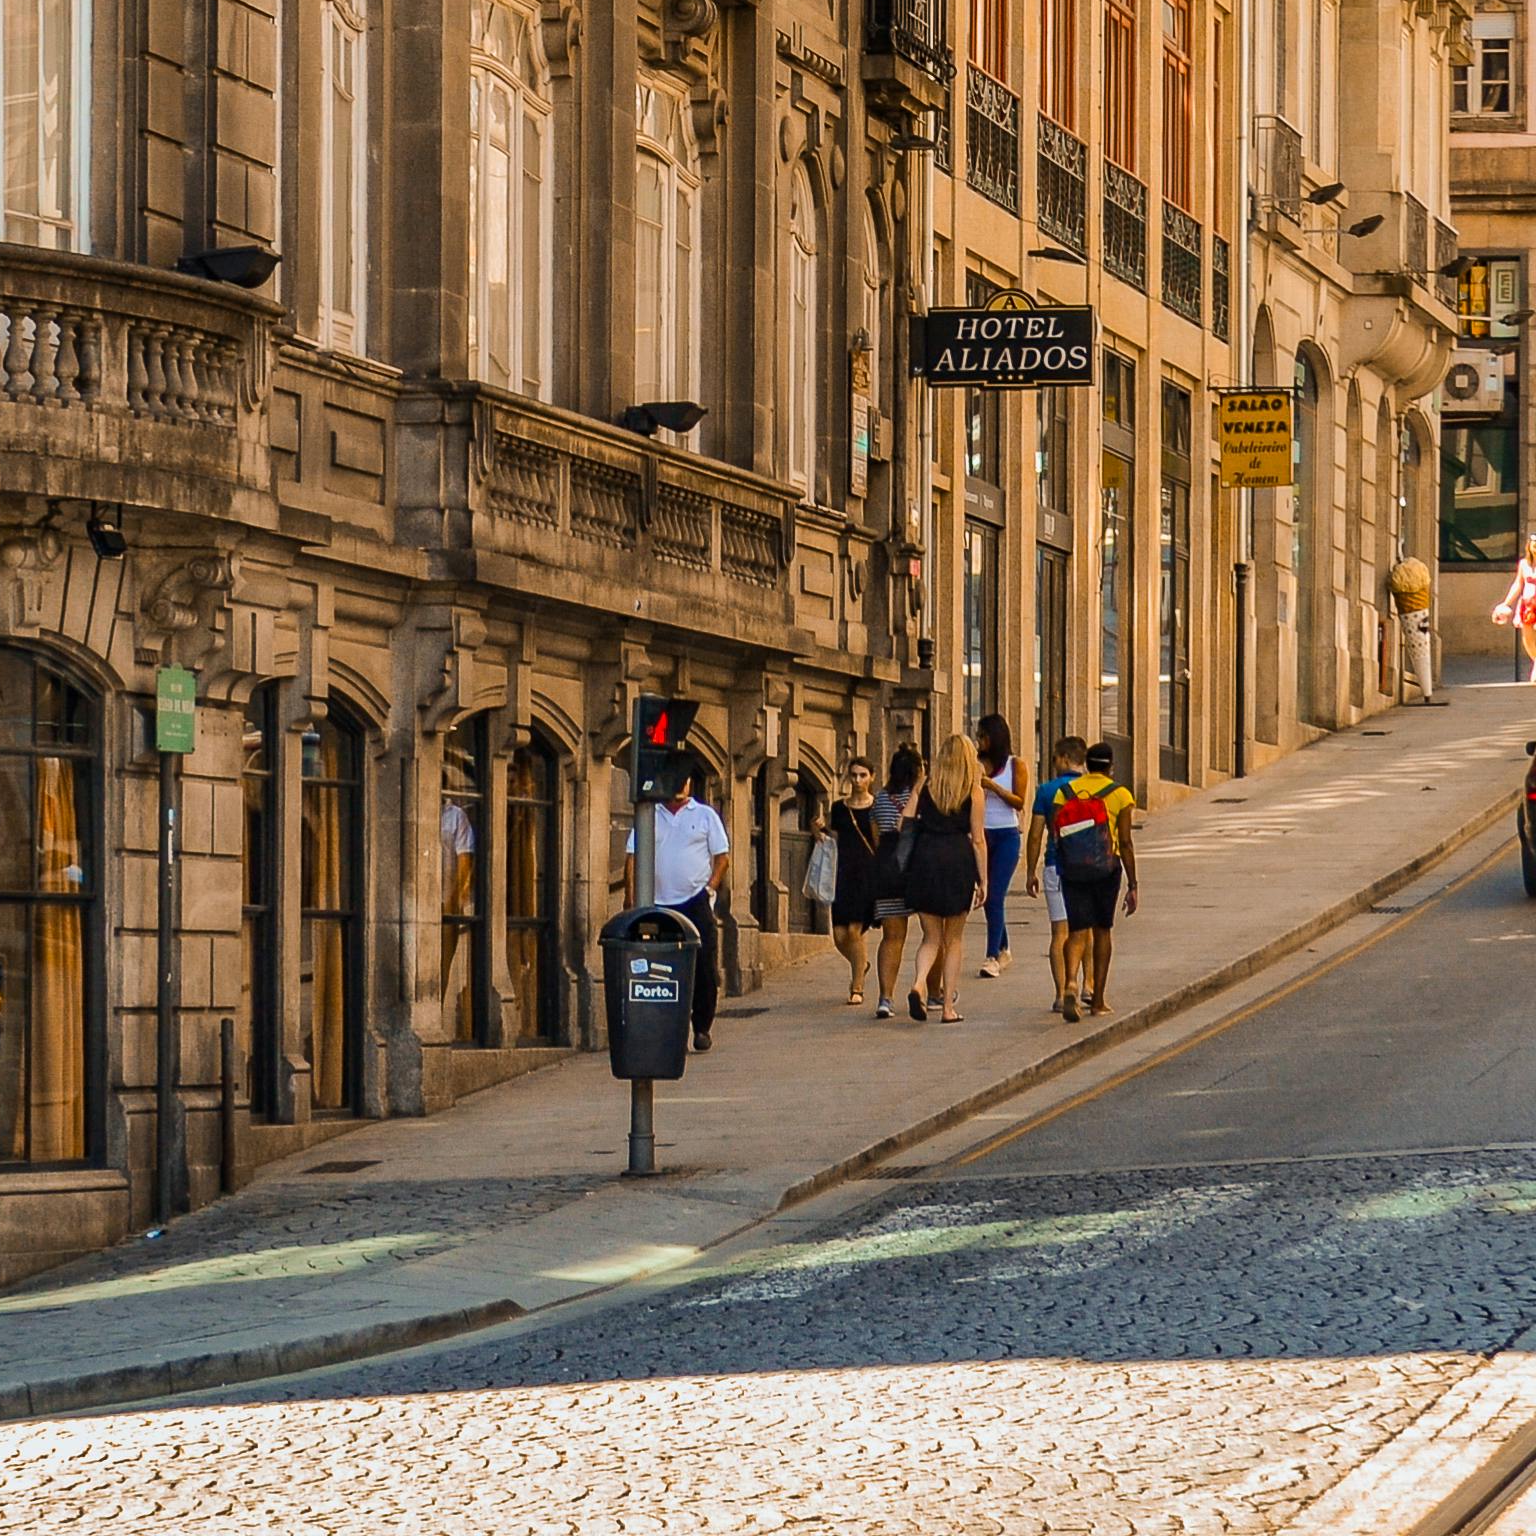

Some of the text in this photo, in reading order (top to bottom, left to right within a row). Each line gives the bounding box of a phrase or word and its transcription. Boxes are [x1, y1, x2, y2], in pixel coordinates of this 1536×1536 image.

[1002, 295, 1018, 310] A
[955, 317, 1064, 341] HOTEL
[932, 345, 1088, 372] ALIADOS
[1223, 420, 1288, 434] VENEZA
[1248, 456, 1262, 469] de
[634, 984, 673, 997] Porto.
